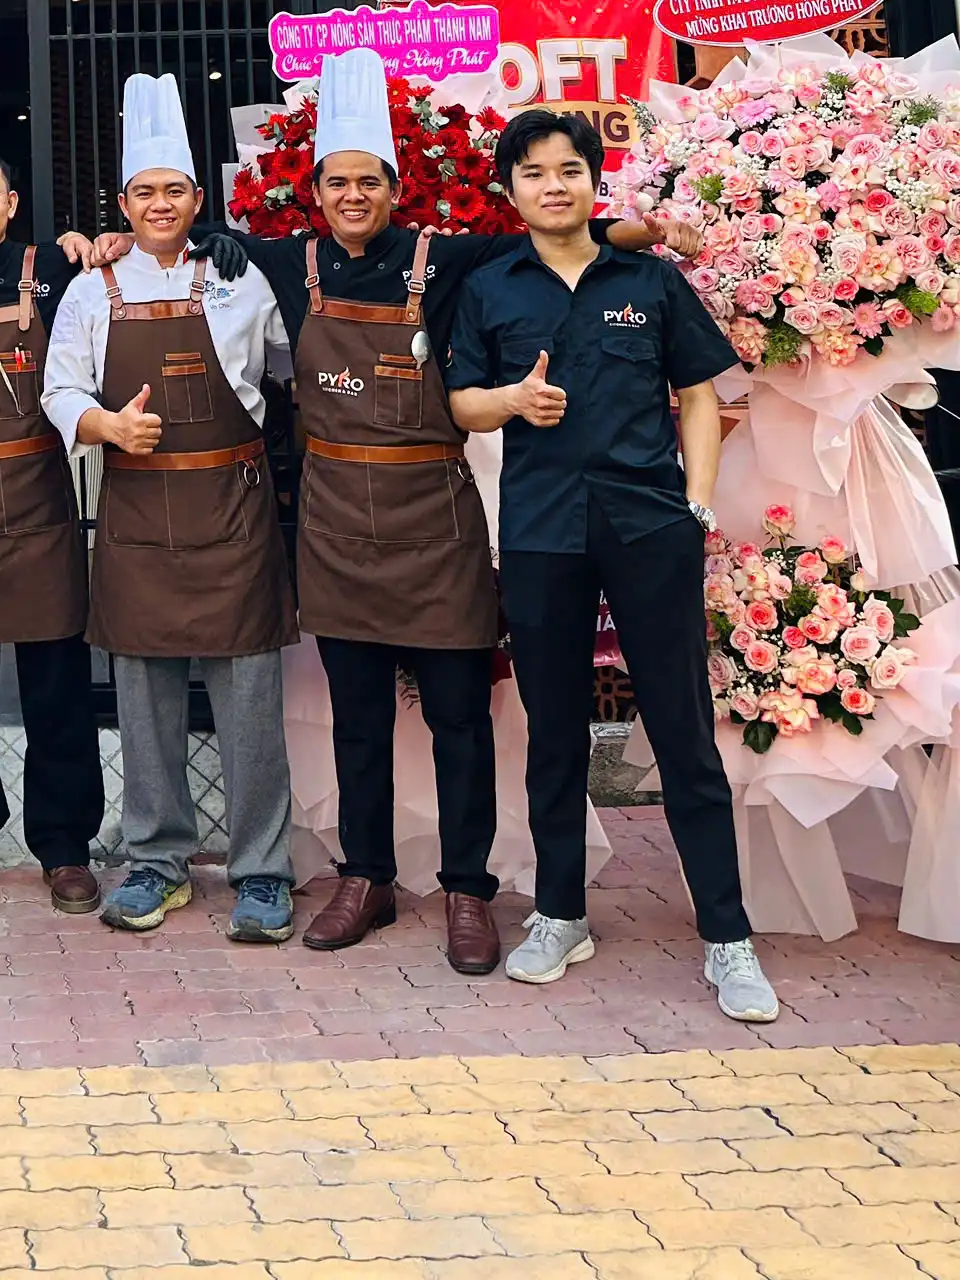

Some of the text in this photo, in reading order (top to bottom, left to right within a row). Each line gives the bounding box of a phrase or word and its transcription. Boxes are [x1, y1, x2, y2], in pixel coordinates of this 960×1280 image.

[277, 21, 301, 49] CÔNG
[302, 24, 313, 48] TY
[316, 23, 328, 47] CP
[330, 18, 356, 47] NÔNG
[357, 14, 375, 46] SẢN
[433, 13, 466, 43] THÀNH
[469, 16, 492, 41] NAM
[685, 13, 719, 38] MỪNG
[719, 13, 747, 32] KHAI
[747, 3, 794, 27] TRƯƠNG
[282, 54, 312, 72] Chúc
[447, 47, 490, 67] Phát
[496, 38, 628, 107] OFT
[603, 302, 647, 324] PYRO
[318, 366, 365, 391] PYRO
